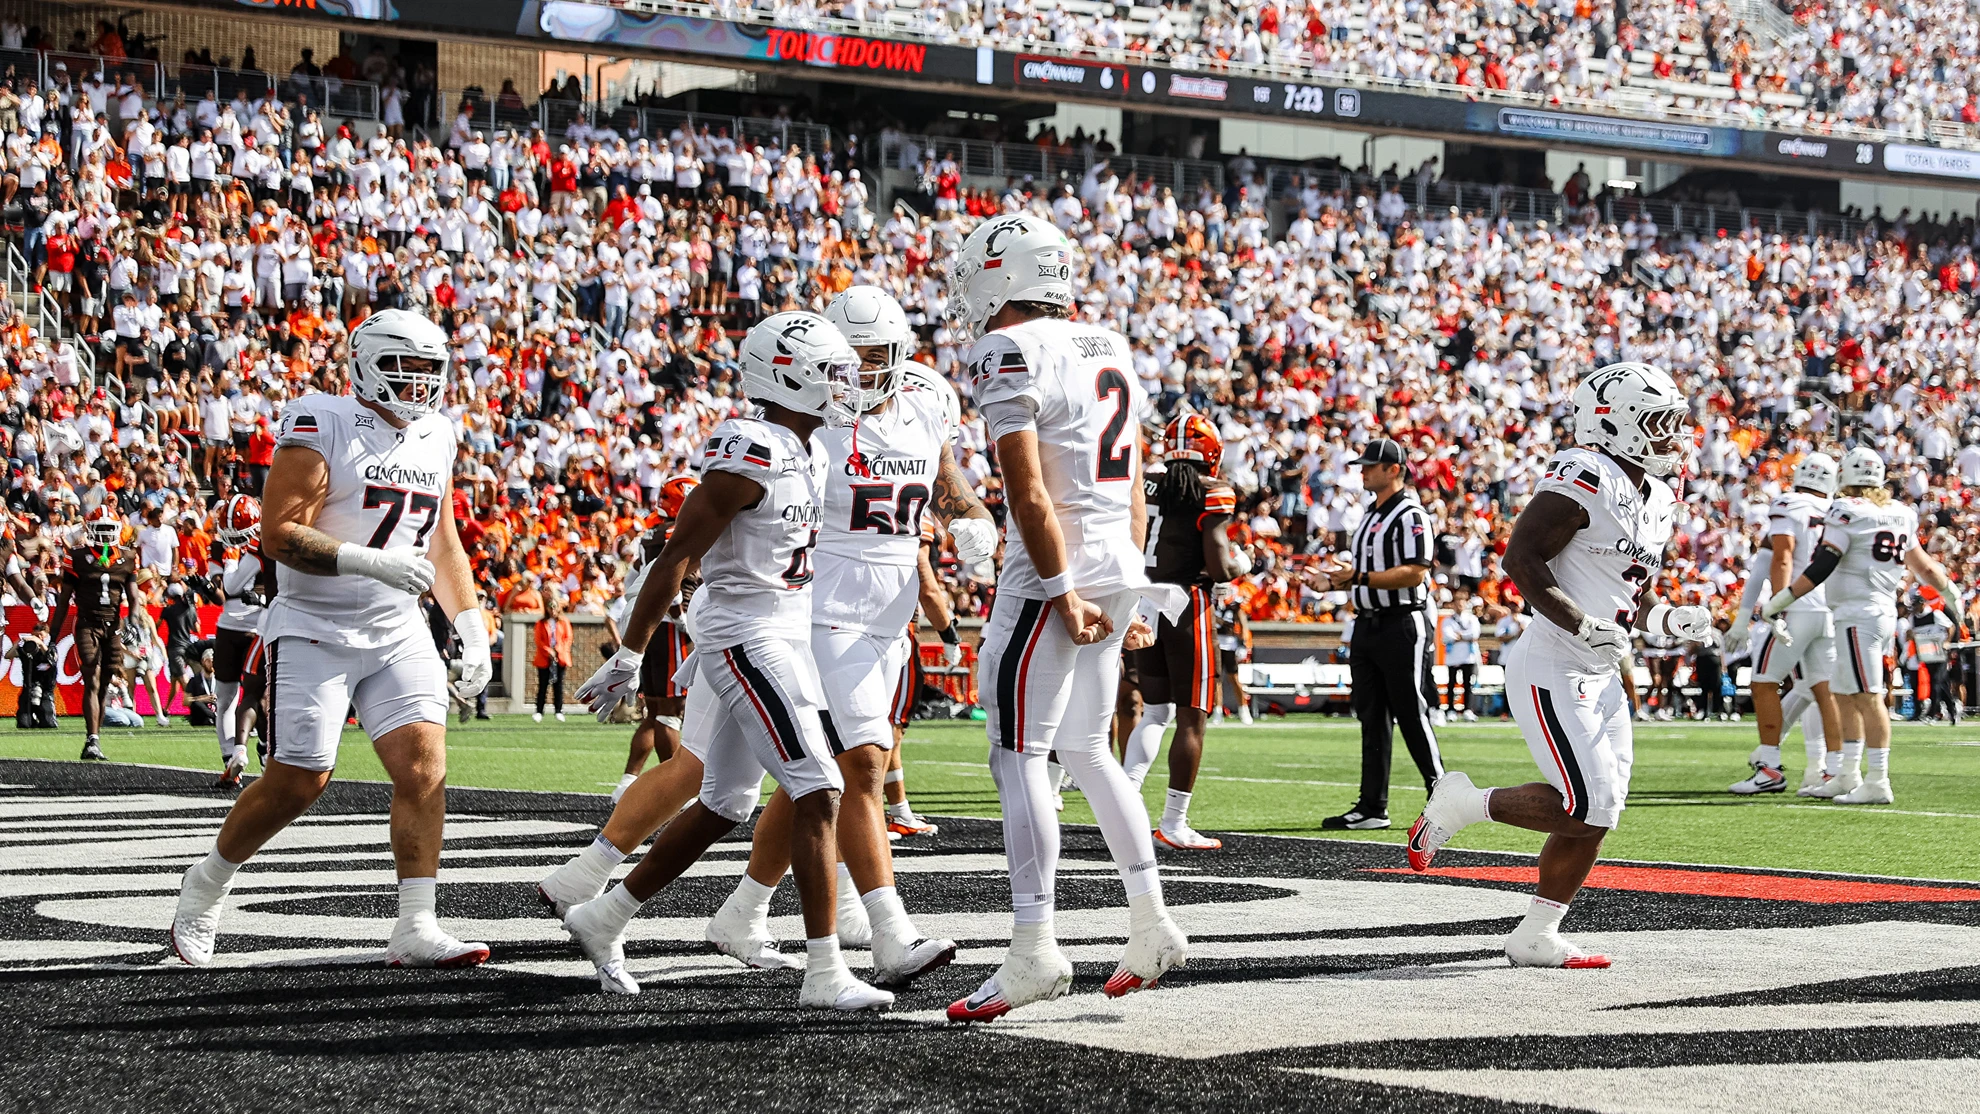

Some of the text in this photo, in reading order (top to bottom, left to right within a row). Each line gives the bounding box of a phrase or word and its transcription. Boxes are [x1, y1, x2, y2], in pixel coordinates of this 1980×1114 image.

[766, 28, 926, 73] TOUCHDOWN
[1023, 60, 1156, 94] CINCINNATI 6 0
[1253, 85, 1271, 103] 1ST
[1284, 84, 1324, 113] 7:23
[1904, 151, 1971, 171] TOTAL YARDS
[1095, 367, 1132, 483] 2
[365, 463, 438, 486] CINCINNATI
[844, 454, 927, 476] CCINNATI
[363, 485, 439, 549] 77
[849, 483, 929, 535] 50
[99, 573, 111, 605] 1
